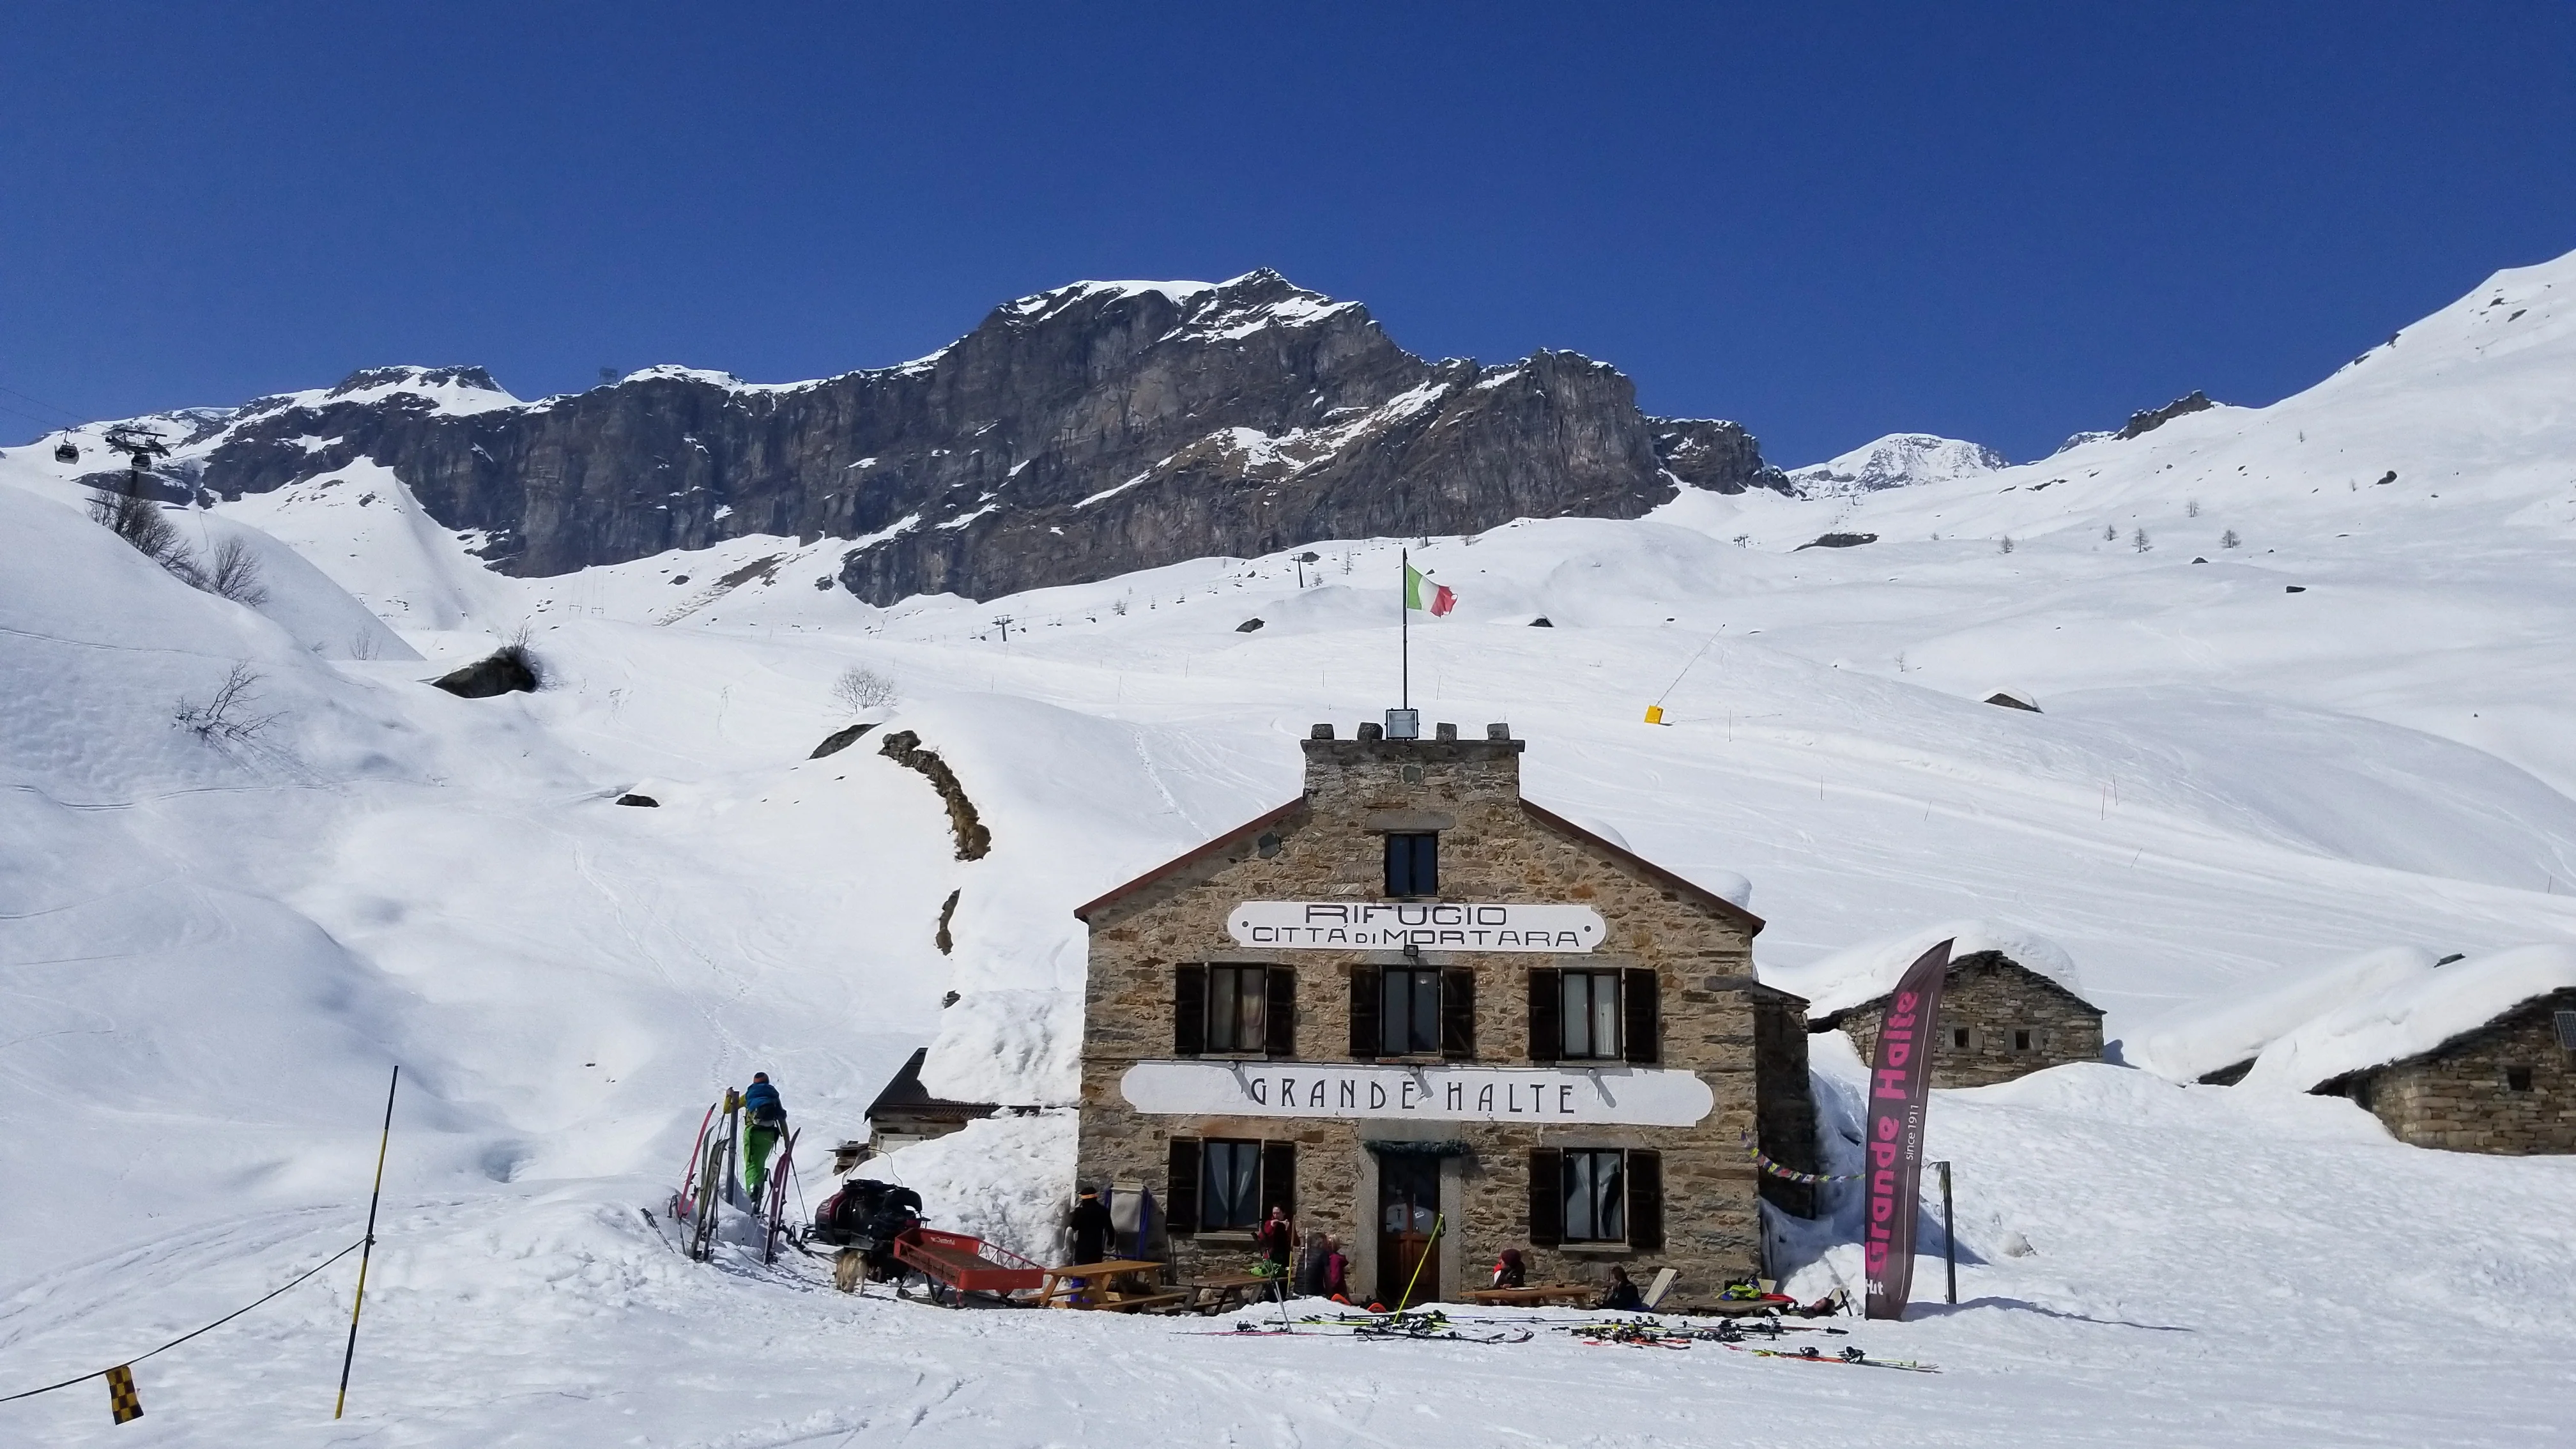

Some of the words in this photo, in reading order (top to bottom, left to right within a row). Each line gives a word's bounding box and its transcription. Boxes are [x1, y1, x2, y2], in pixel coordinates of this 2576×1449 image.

[1306, 904, 1506, 926] RIFUGIO
[1383, 928, 1580, 947] MORTARA
[1875, 991, 1919, 1100] Halte
[1250, 1077, 1415, 1110] GRANDE
[1446, 1082, 1575, 1114] HALTE
[1907, 1105, 1919, 1130] 1911
[1904, 1131, 1916, 1161] since
[1865, 1116, 1900, 1273] Grande
